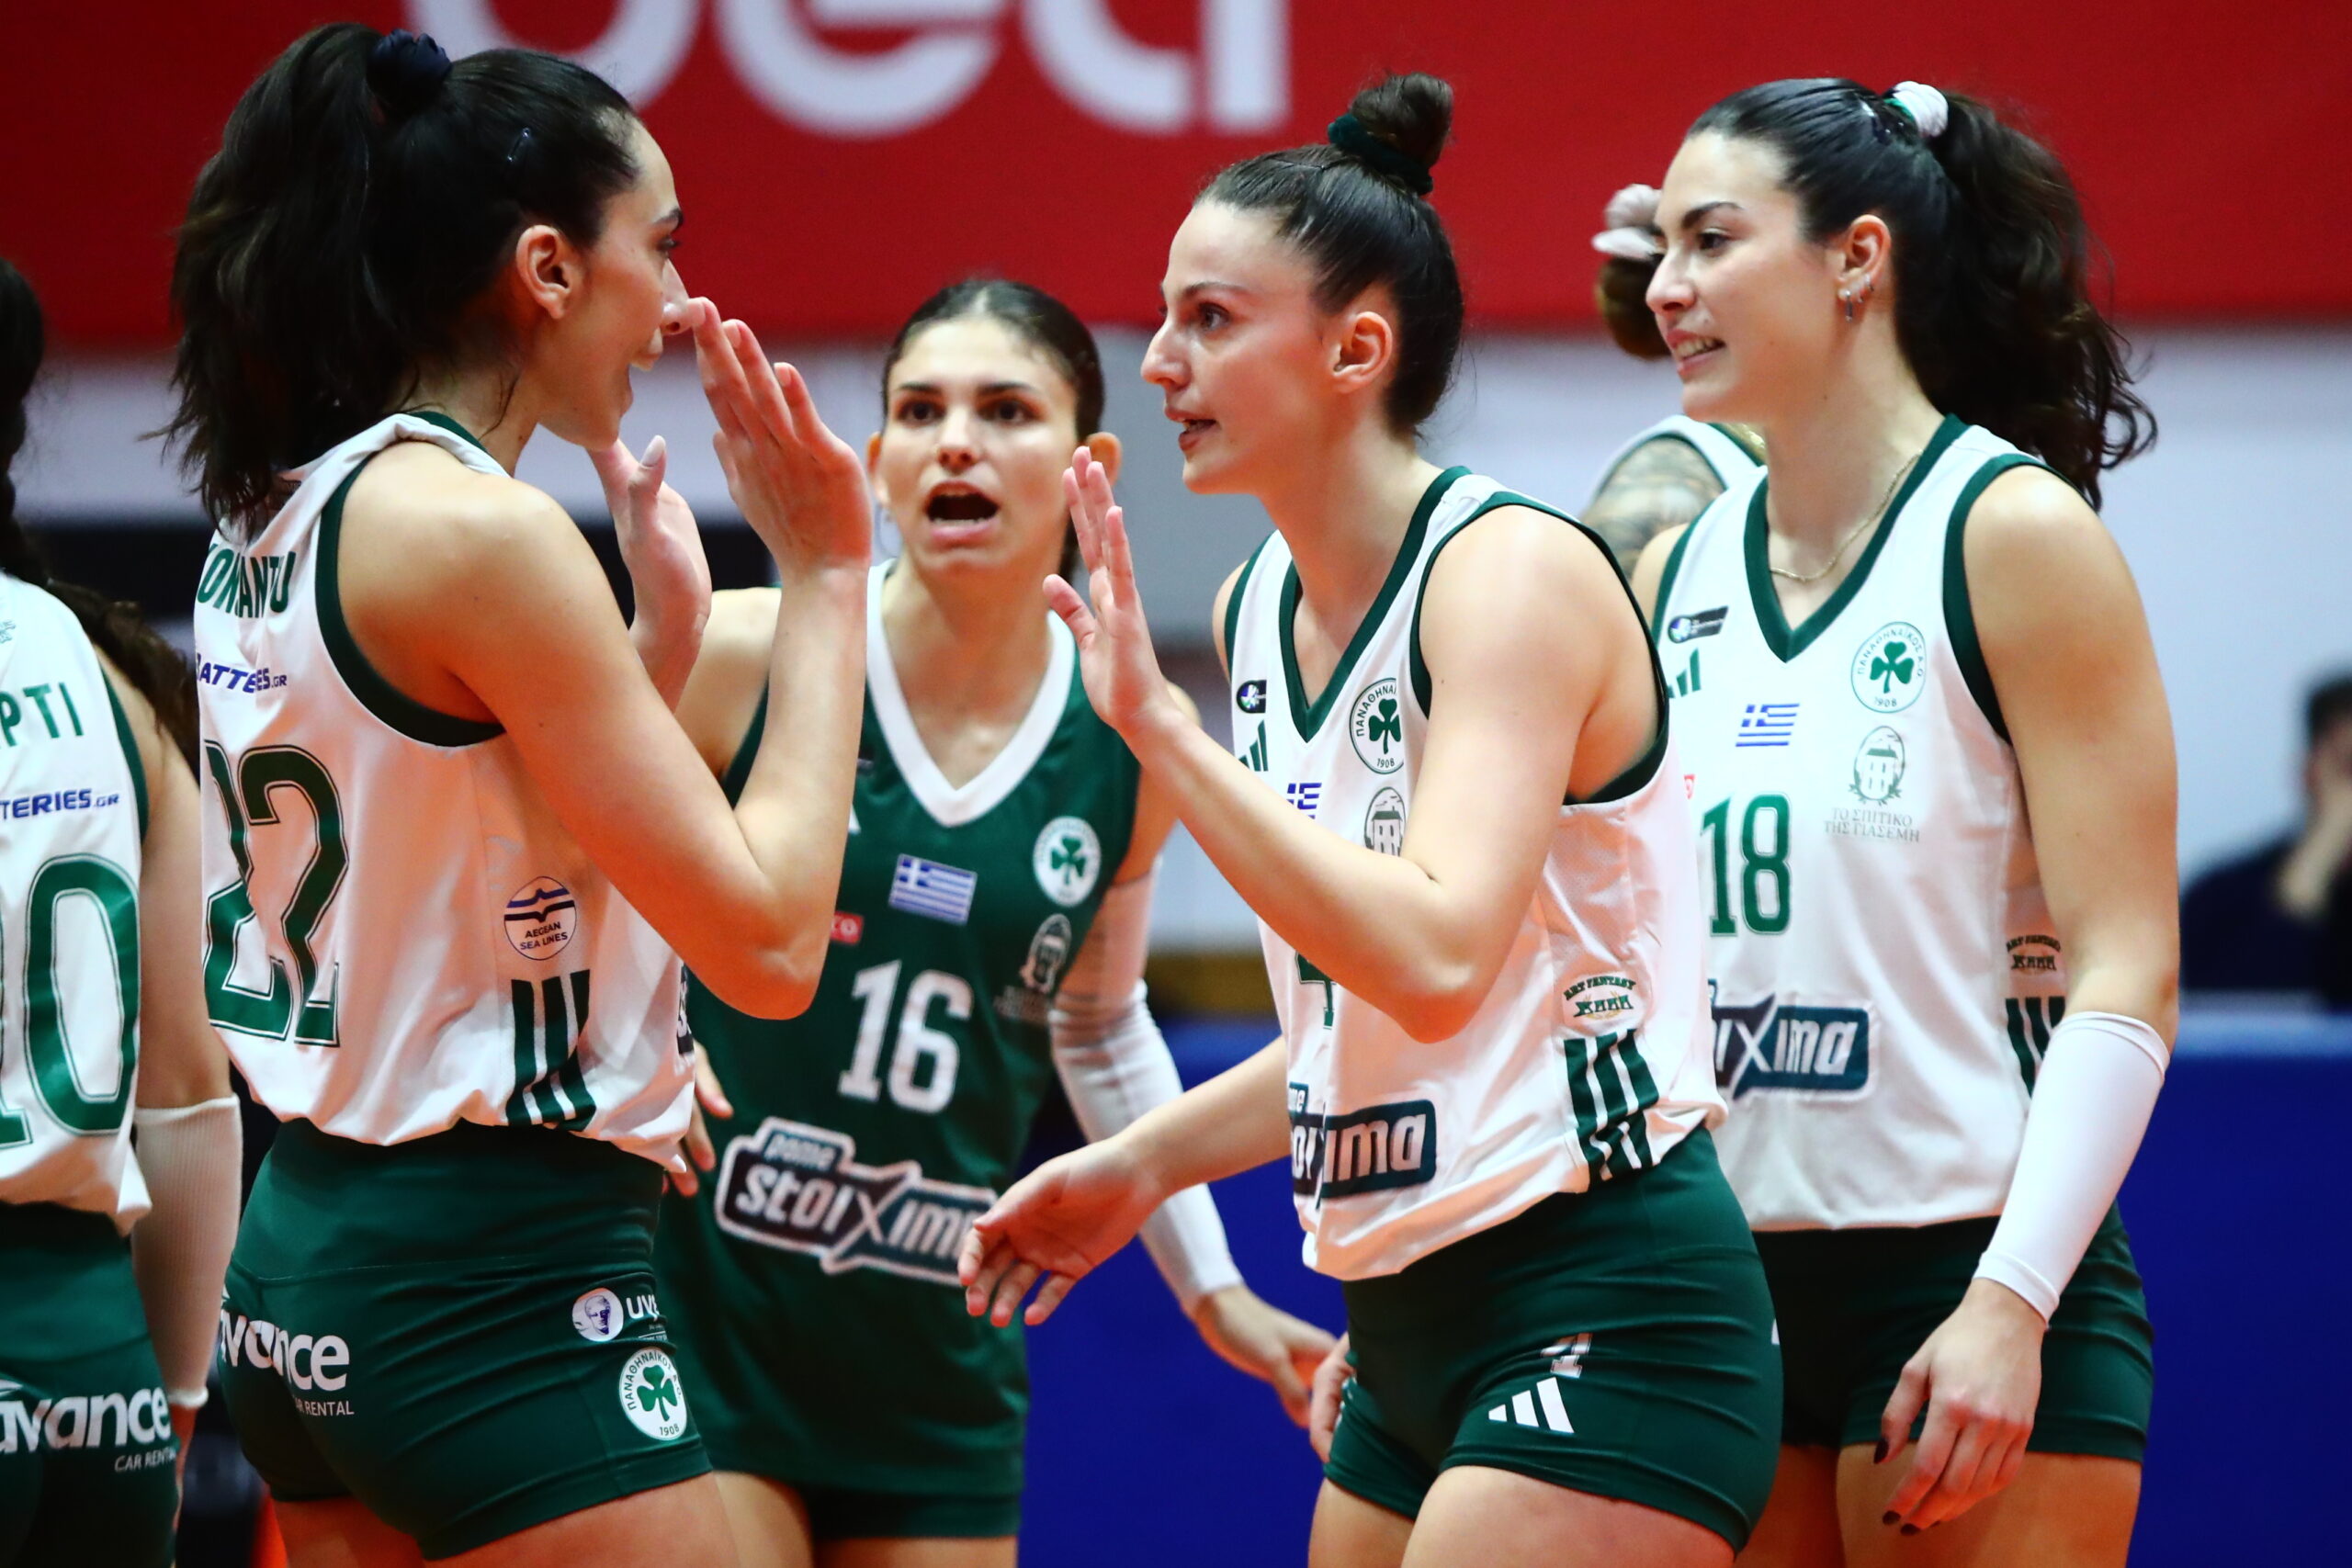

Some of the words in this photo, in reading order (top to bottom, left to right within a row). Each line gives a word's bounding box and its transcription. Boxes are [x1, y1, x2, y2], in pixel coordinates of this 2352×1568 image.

[1377, 758, 1395, 768] 1908
[1700, 791, 1792, 937] 18
[525, 921, 561, 939] AEGEAN
[520, 939, 541, 950] SEA
[542, 931, 568, 946] LINES
[0, 852, 141, 1145] 0
[837, 959, 974, 1114] 16
[305, 1401, 355, 1416] RENTAL
[660, 1424, 680, 1437] 1908
[115, 1455, 142, 1472] CAR
